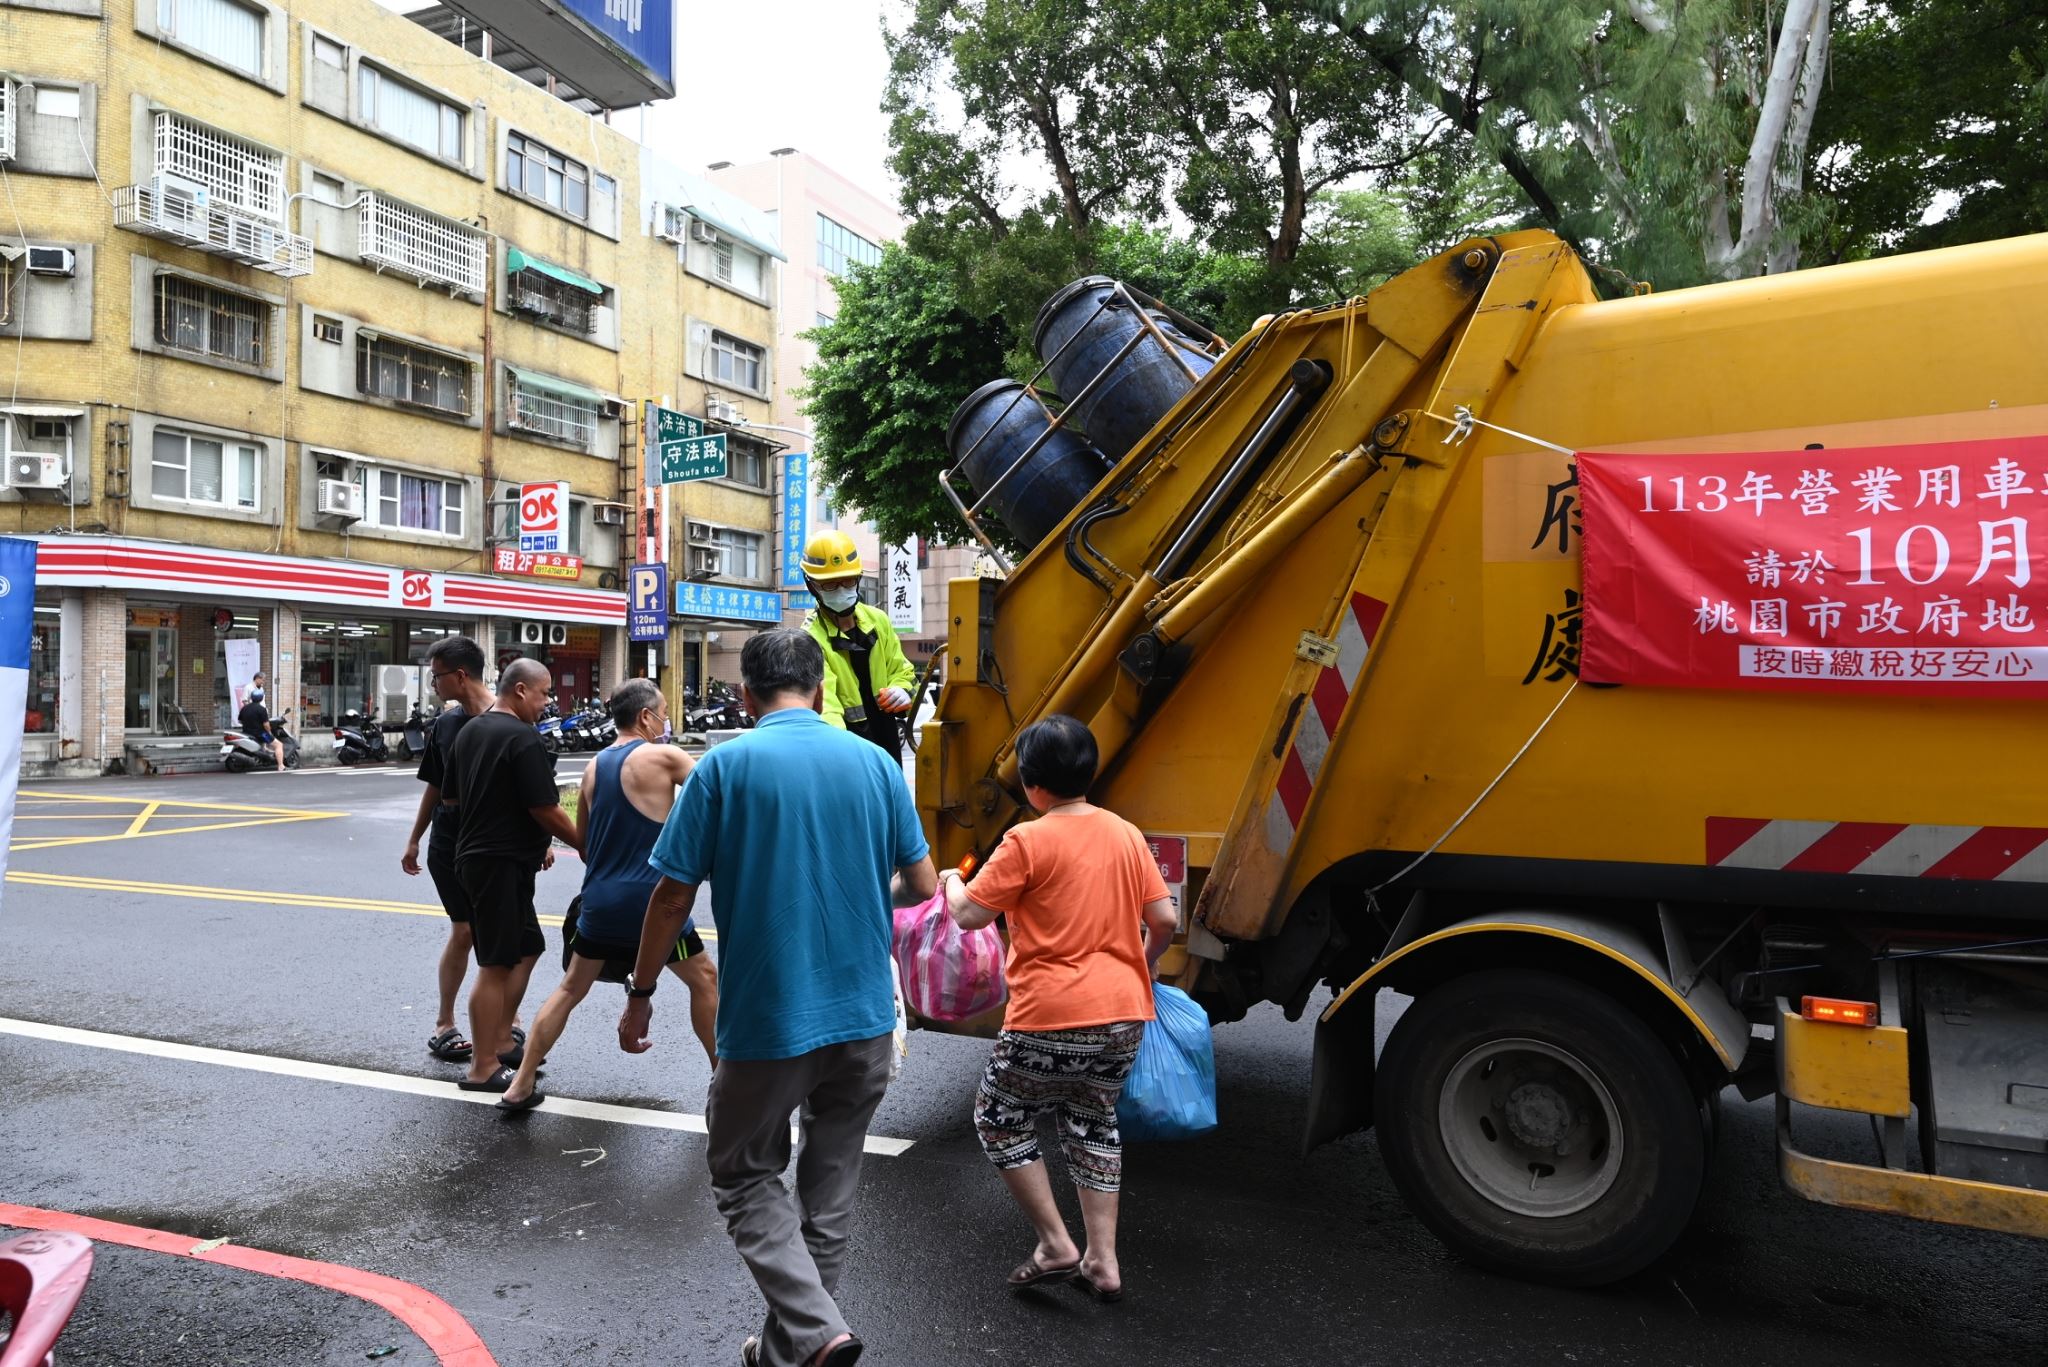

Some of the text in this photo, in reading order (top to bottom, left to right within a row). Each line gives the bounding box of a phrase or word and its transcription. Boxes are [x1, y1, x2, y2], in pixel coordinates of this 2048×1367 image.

[662, 411, 698, 438] 法治路
[667, 440, 719, 464] 守法路
[668, 466, 719, 479] Shoufa Rd.
[1637, 457, 2048, 516] 113年營業用車
[521, 492, 558, 522] OK
[1744, 516, 2032, 588] 請於10月
[403, 577, 432, 597] OK
[636, 570, 658, 609] P
[634, 615, 657, 625] 120m
[1694, 594, 2048, 638] 桃園市政府地
[634, 625, 665, 636] 公有停車場
[1753, 648, 2034, 678] 按時繳稅好安心
